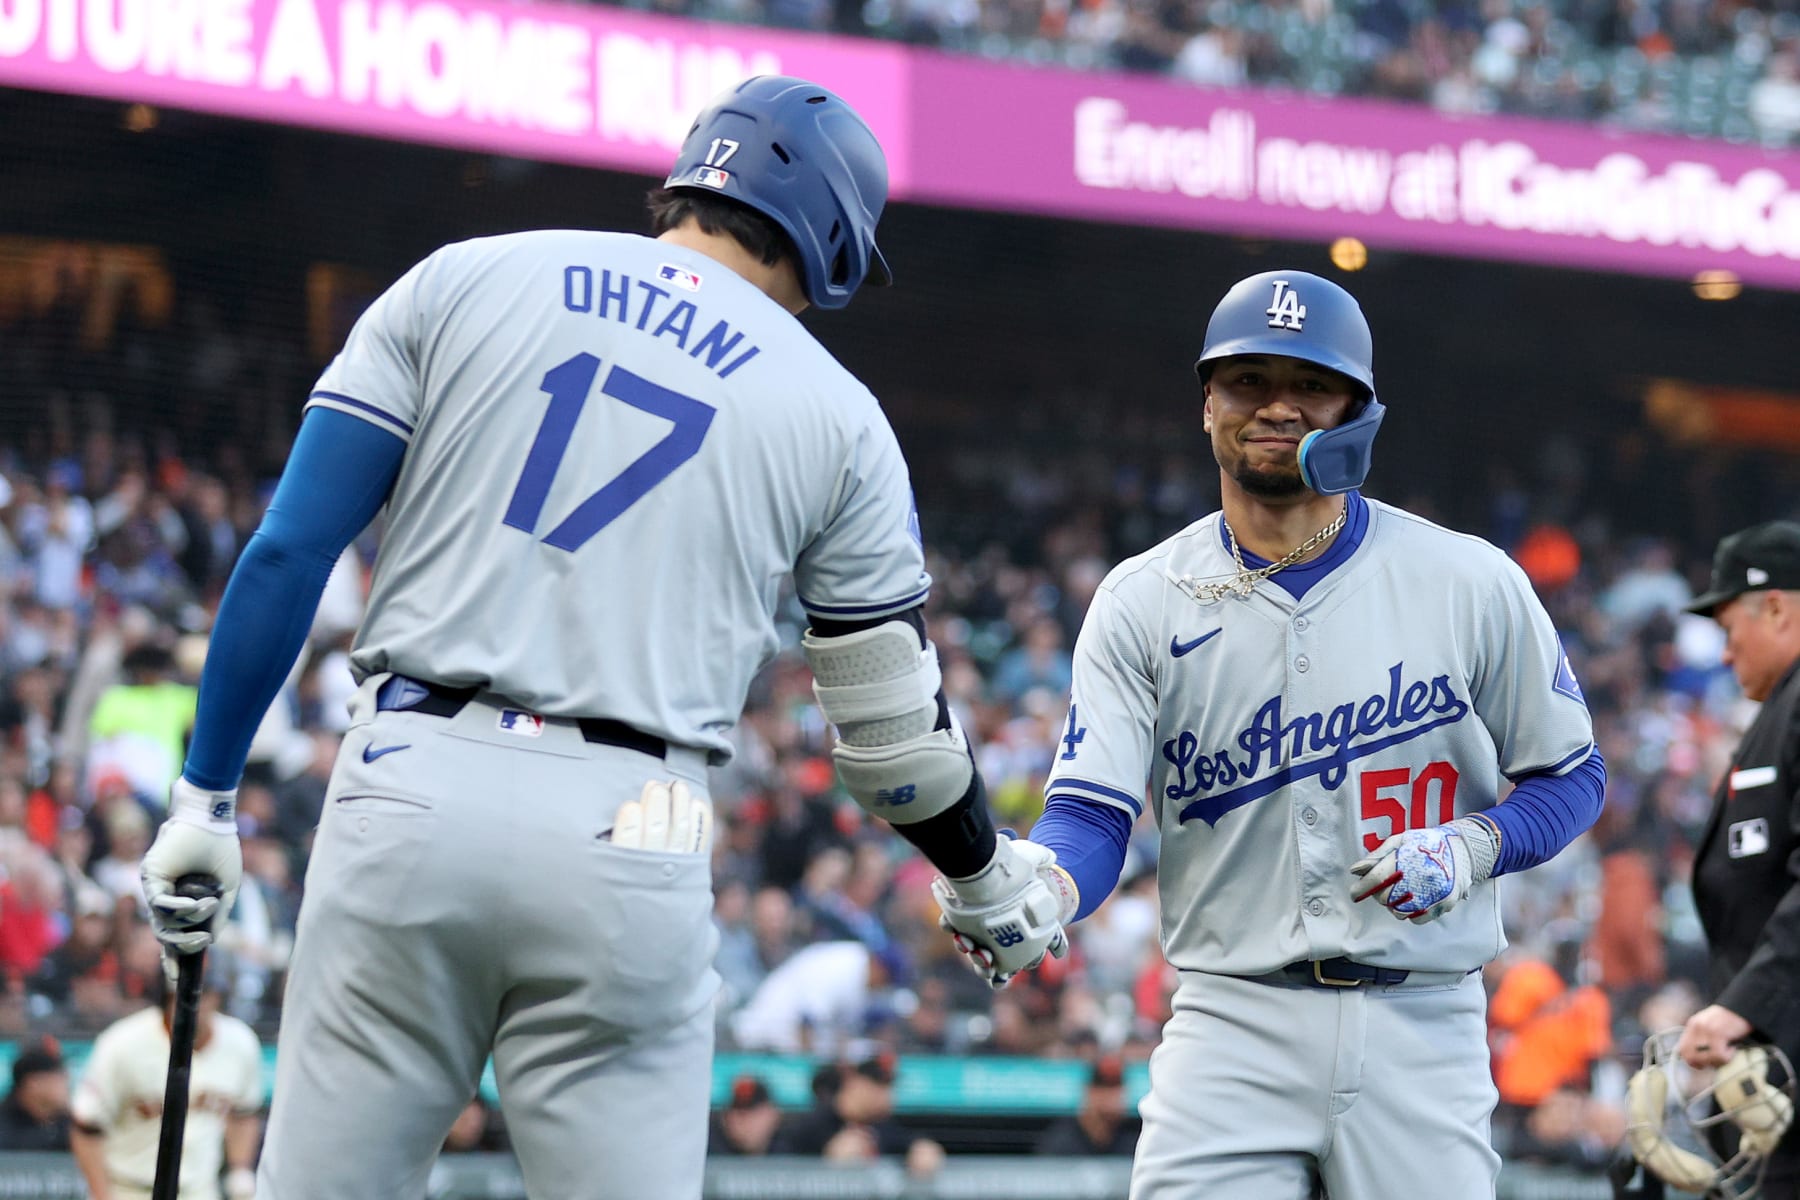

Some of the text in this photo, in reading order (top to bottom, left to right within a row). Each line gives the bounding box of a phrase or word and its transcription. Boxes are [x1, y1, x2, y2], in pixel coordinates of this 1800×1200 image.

[257, 0, 334, 98] A
[338, 0, 595, 136] HOME
[704, 137, 740, 168] 17
[1074, 96, 1256, 200] Enroll
[1256, 137, 1391, 215] now
[1390, 143, 1458, 223] at
[564, 264, 761, 380] OHTANI
[1266, 279, 1308, 331] LA
[502, 351, 717, 553] 17
[1163, 660, 1469, 801] Los Angeles
[1359, 760, 1461, 854] 50
